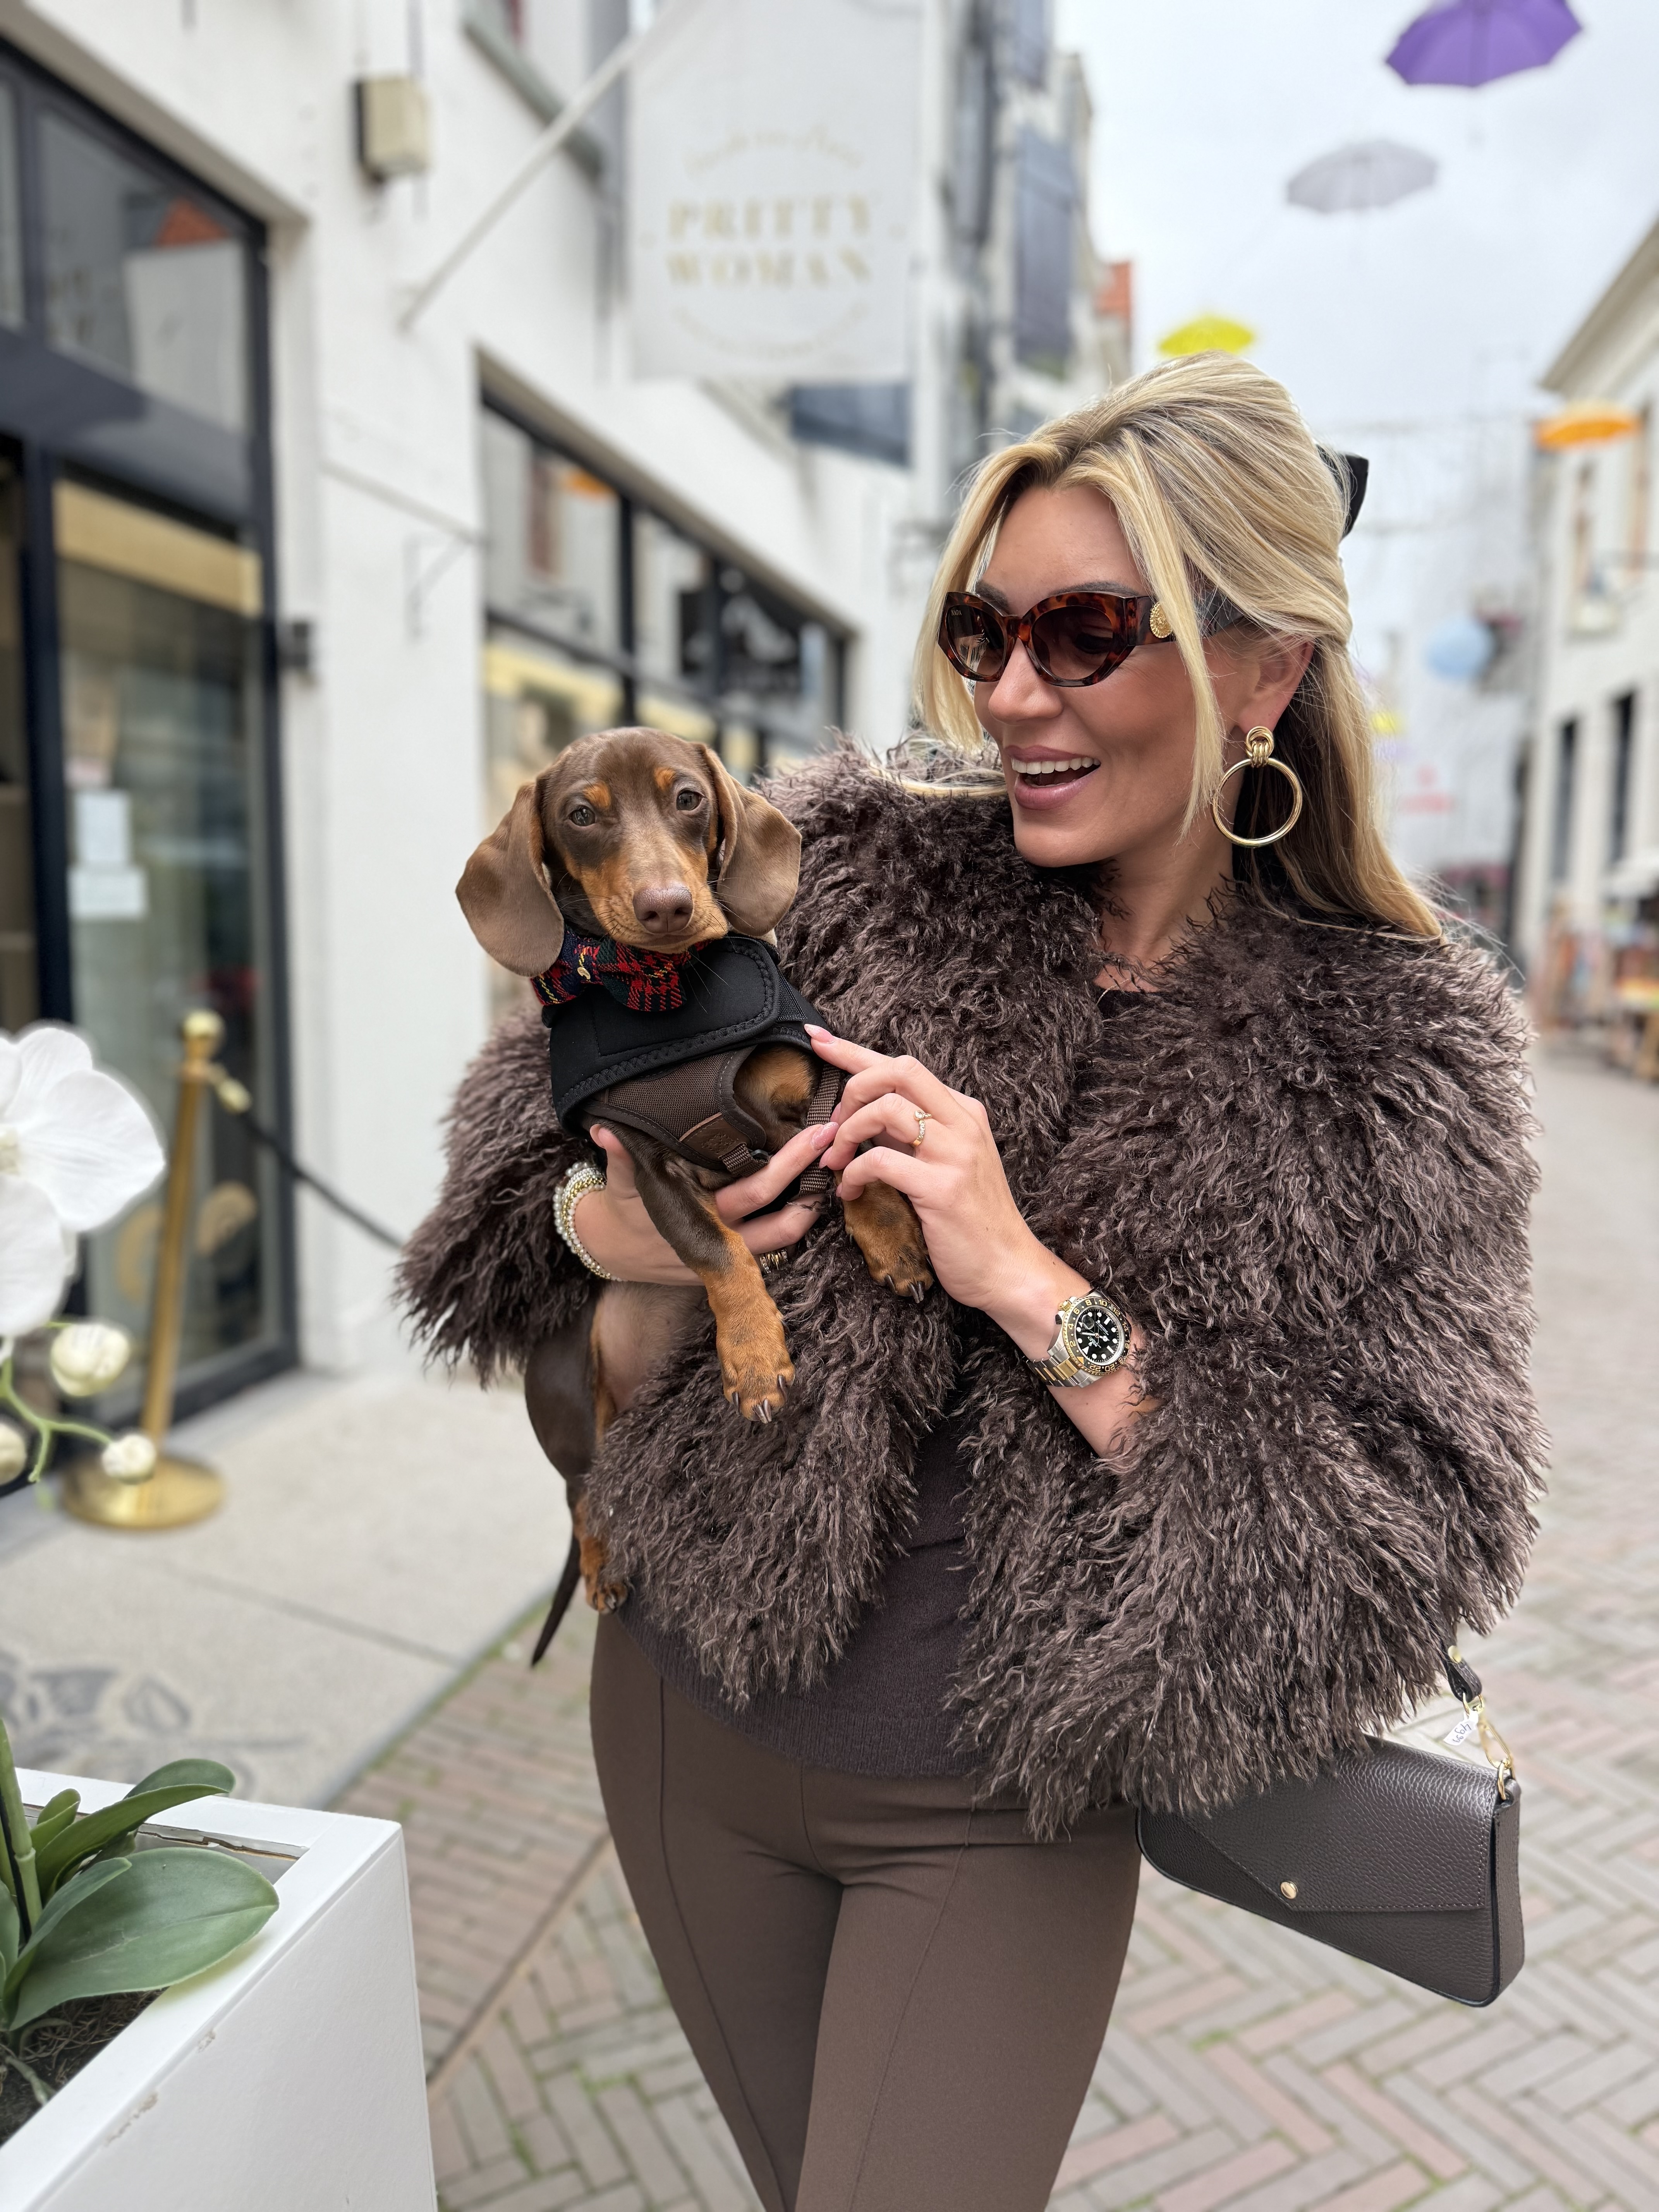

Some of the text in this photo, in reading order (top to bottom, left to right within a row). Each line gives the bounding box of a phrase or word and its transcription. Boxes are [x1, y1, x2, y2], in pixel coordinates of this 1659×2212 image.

[1113, 1307, 1121, 1317] 12
[1122, 1322, 1129, 1331] 14
[1089, 1364, 1101, 1372] 22
[1105, 1363, 1115, 1372] 20
